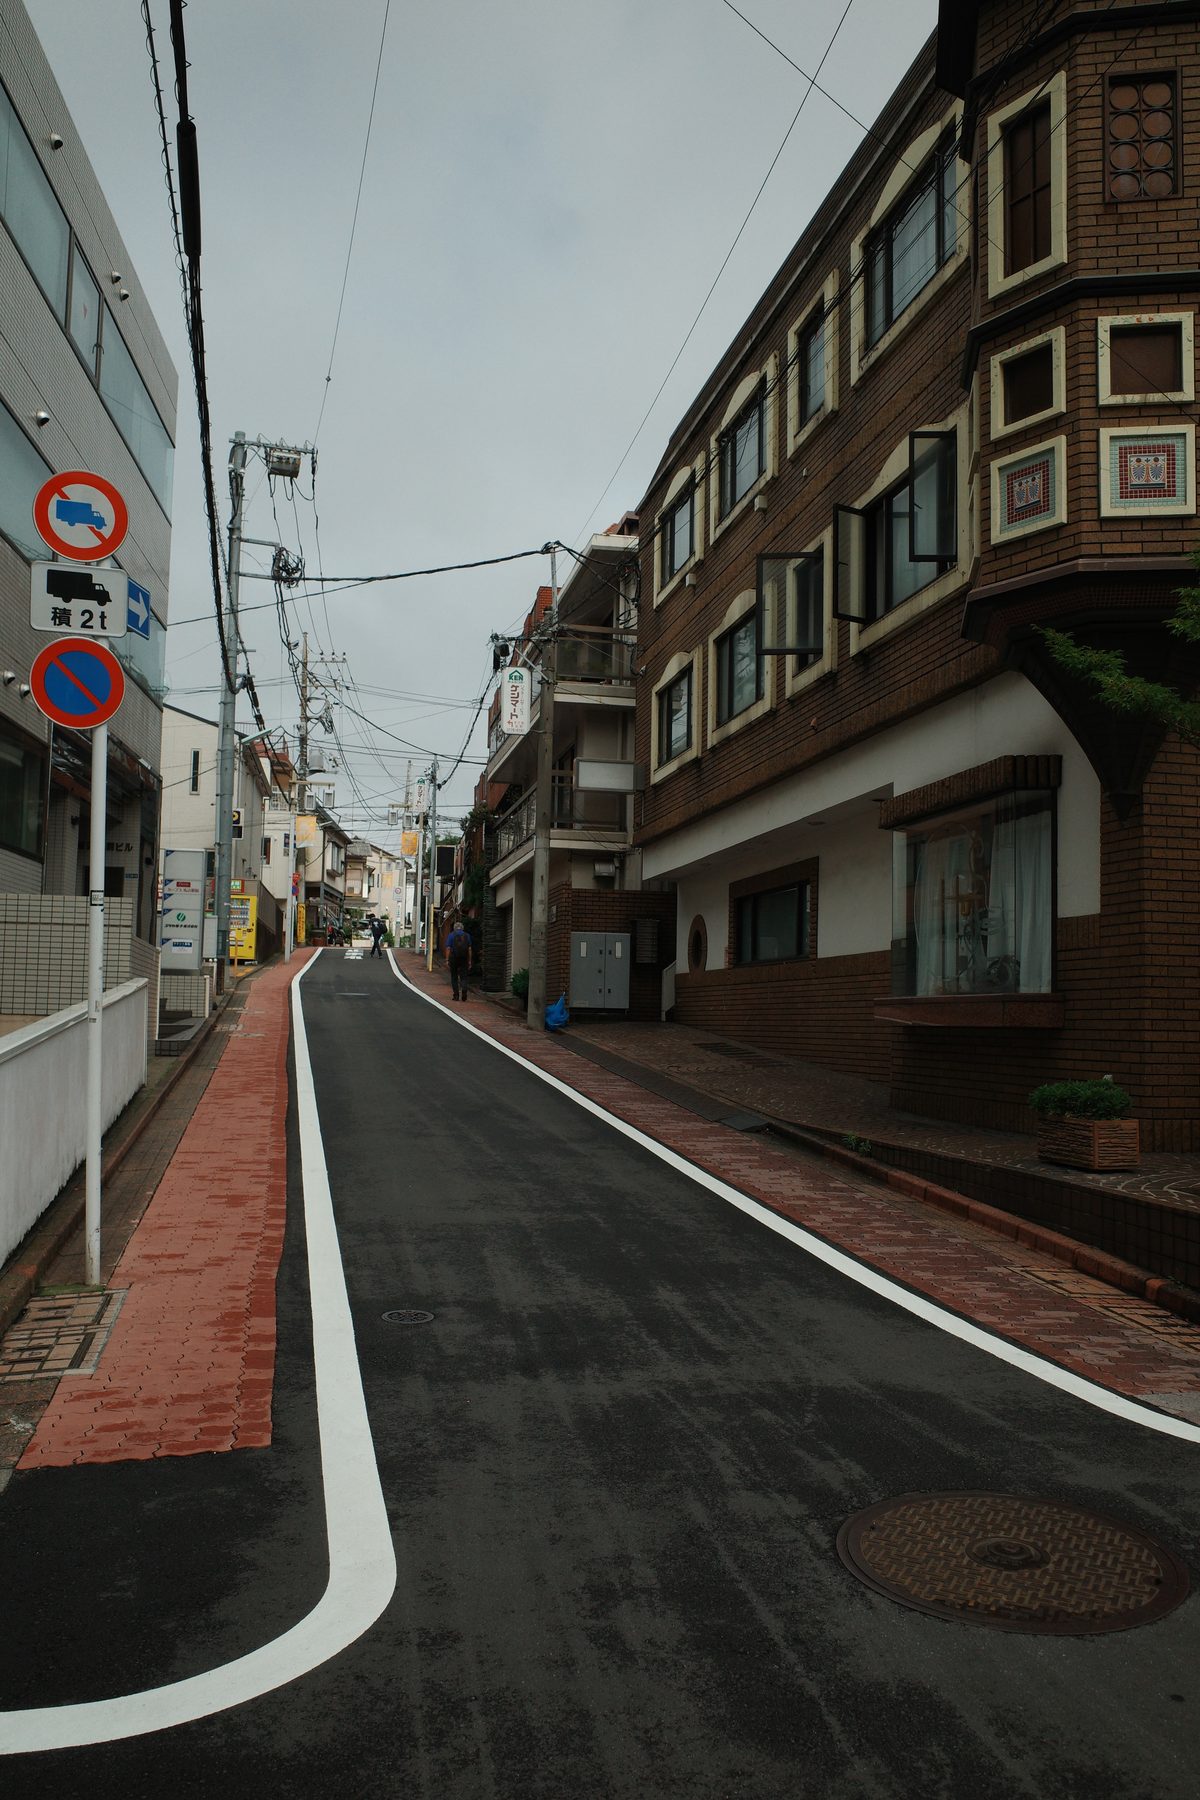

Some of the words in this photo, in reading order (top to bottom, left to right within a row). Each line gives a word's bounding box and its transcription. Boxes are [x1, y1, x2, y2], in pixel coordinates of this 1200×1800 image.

[510, 684, 520, 719] ケンマート
